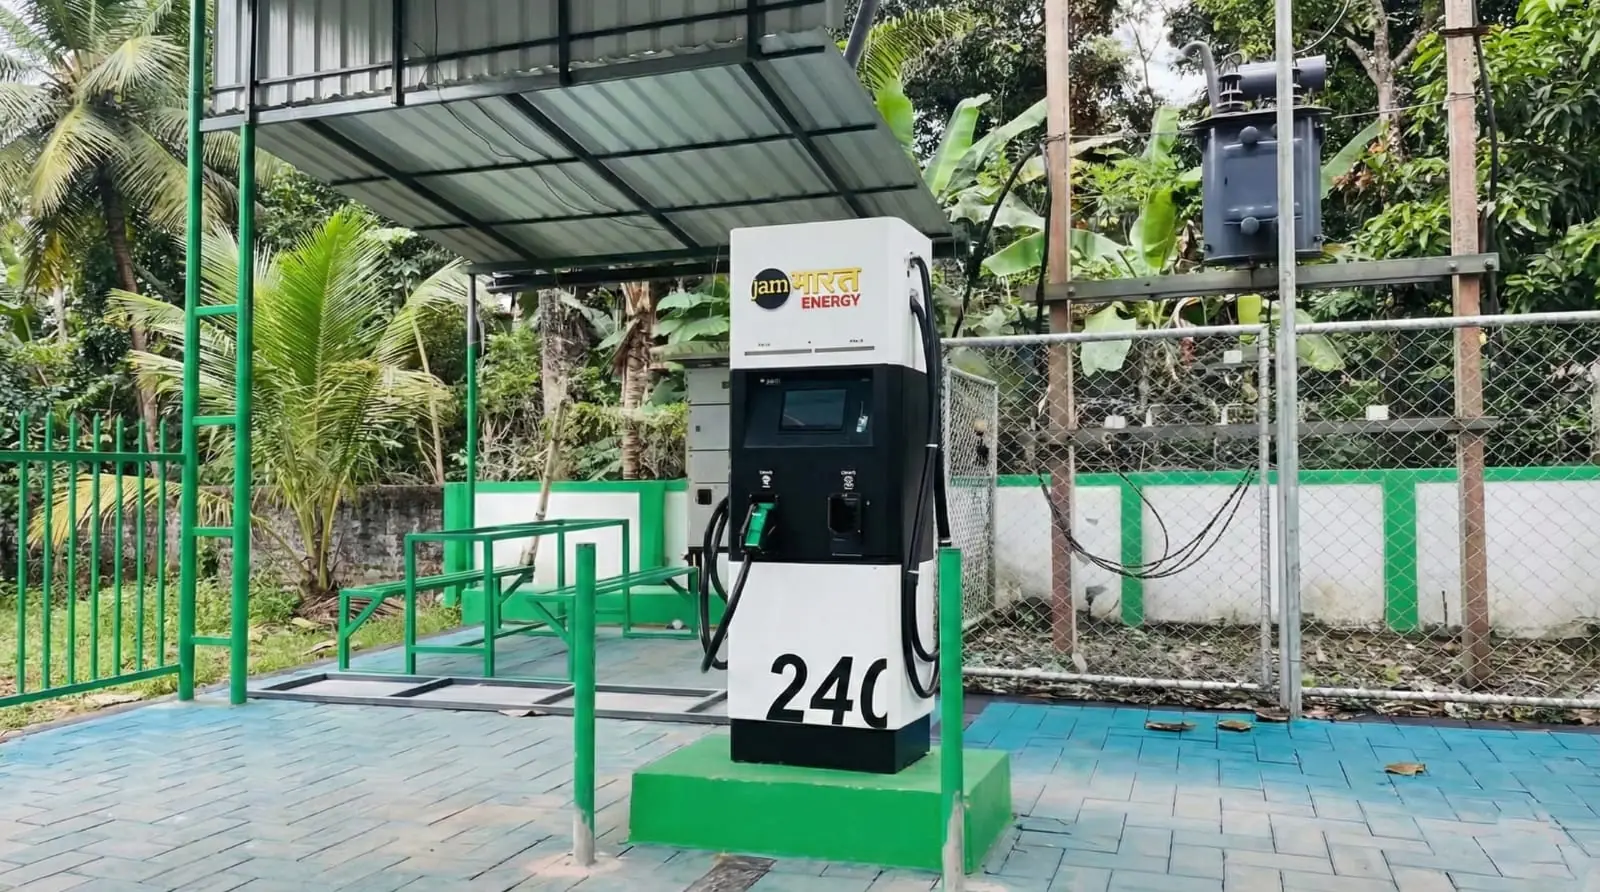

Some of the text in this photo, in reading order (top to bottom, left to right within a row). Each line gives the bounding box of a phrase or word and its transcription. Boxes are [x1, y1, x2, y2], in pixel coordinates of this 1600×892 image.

[751, 278, 789, 301] jam
[791, 268, 862, 294] भारत
[801, 294, 861, 309] ENERGY
